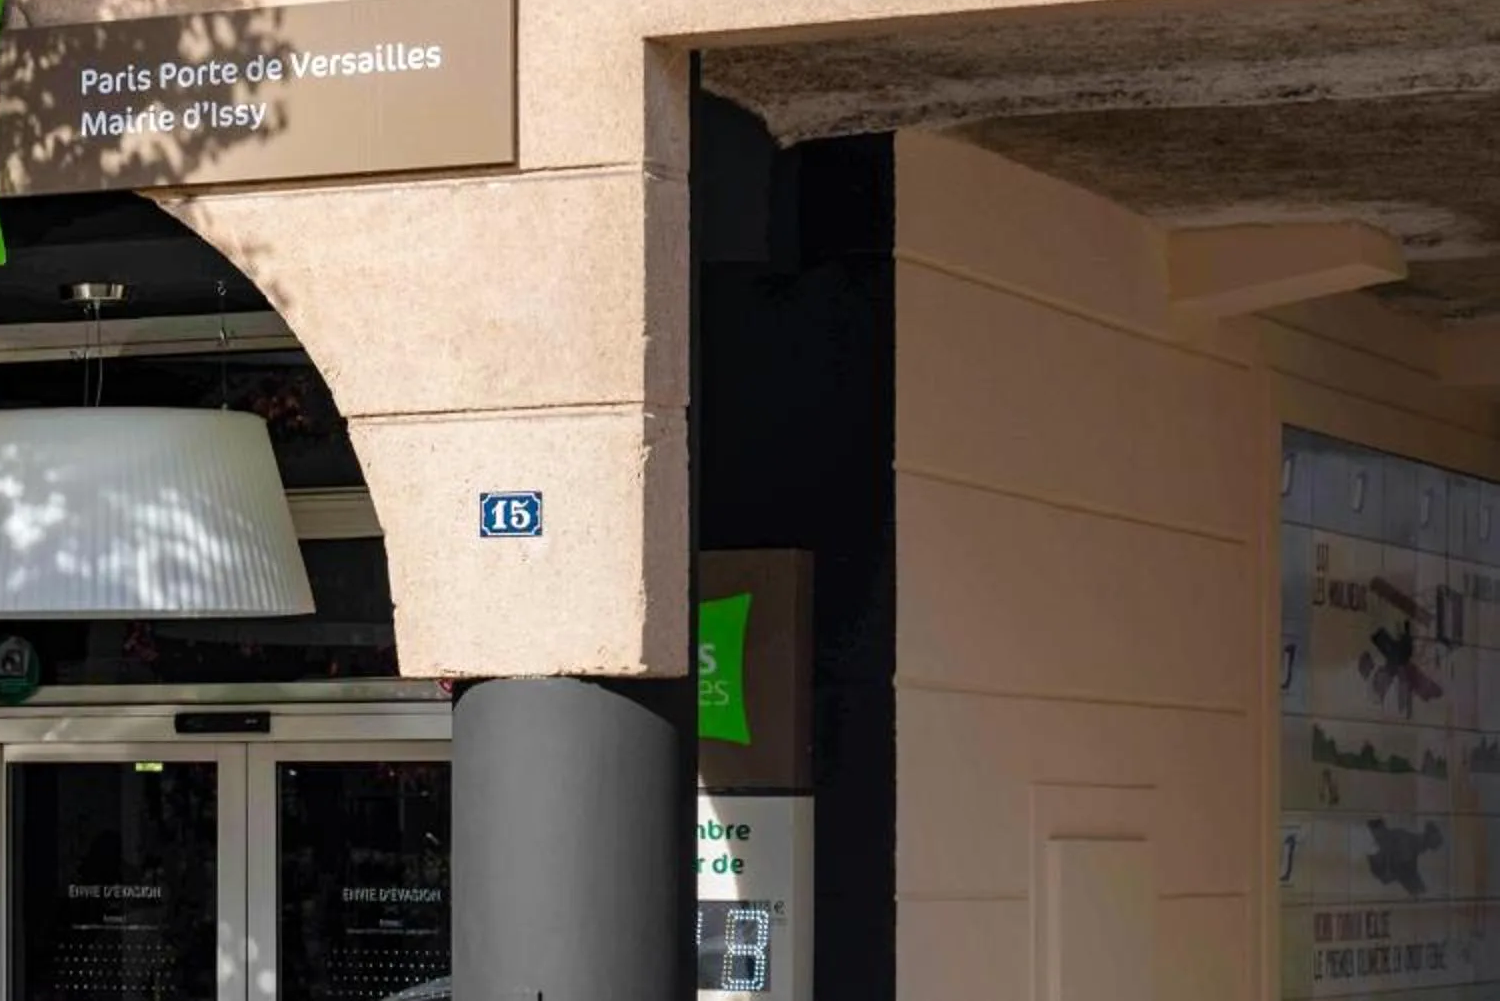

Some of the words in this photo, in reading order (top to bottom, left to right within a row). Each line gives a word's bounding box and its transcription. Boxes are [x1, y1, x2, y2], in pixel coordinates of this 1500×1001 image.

[81, 64, 151, 95] Paris
[159, 60, 237, 90] Porte
[246, 55, 283, 82] de
[290, 43, 442, 78] Versailles
[81, 105, 174, 137] Mairie
[491, 500, 531, 530] 15
[713, 854, 744, 874] de
